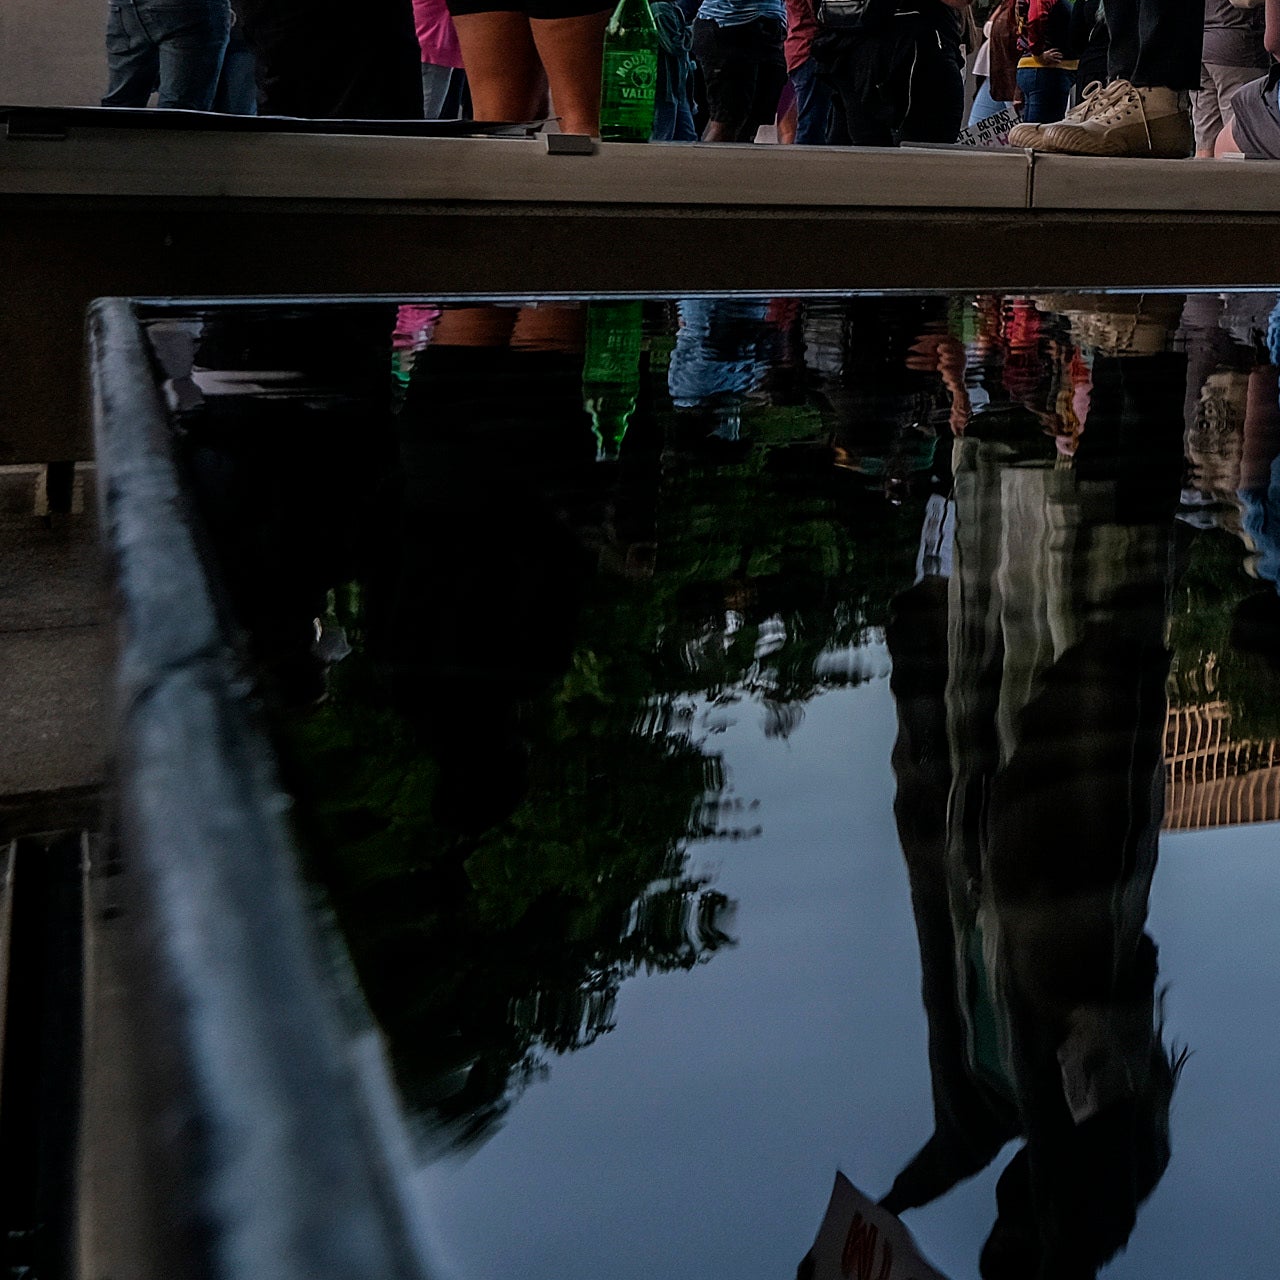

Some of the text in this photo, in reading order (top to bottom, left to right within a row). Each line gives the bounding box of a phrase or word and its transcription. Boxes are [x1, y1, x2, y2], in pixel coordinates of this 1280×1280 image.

[622, 87, 656, 99] VALLE
[976, 109, 1011, 131] BEGINS
[978, 129, 991, 142] YOU
